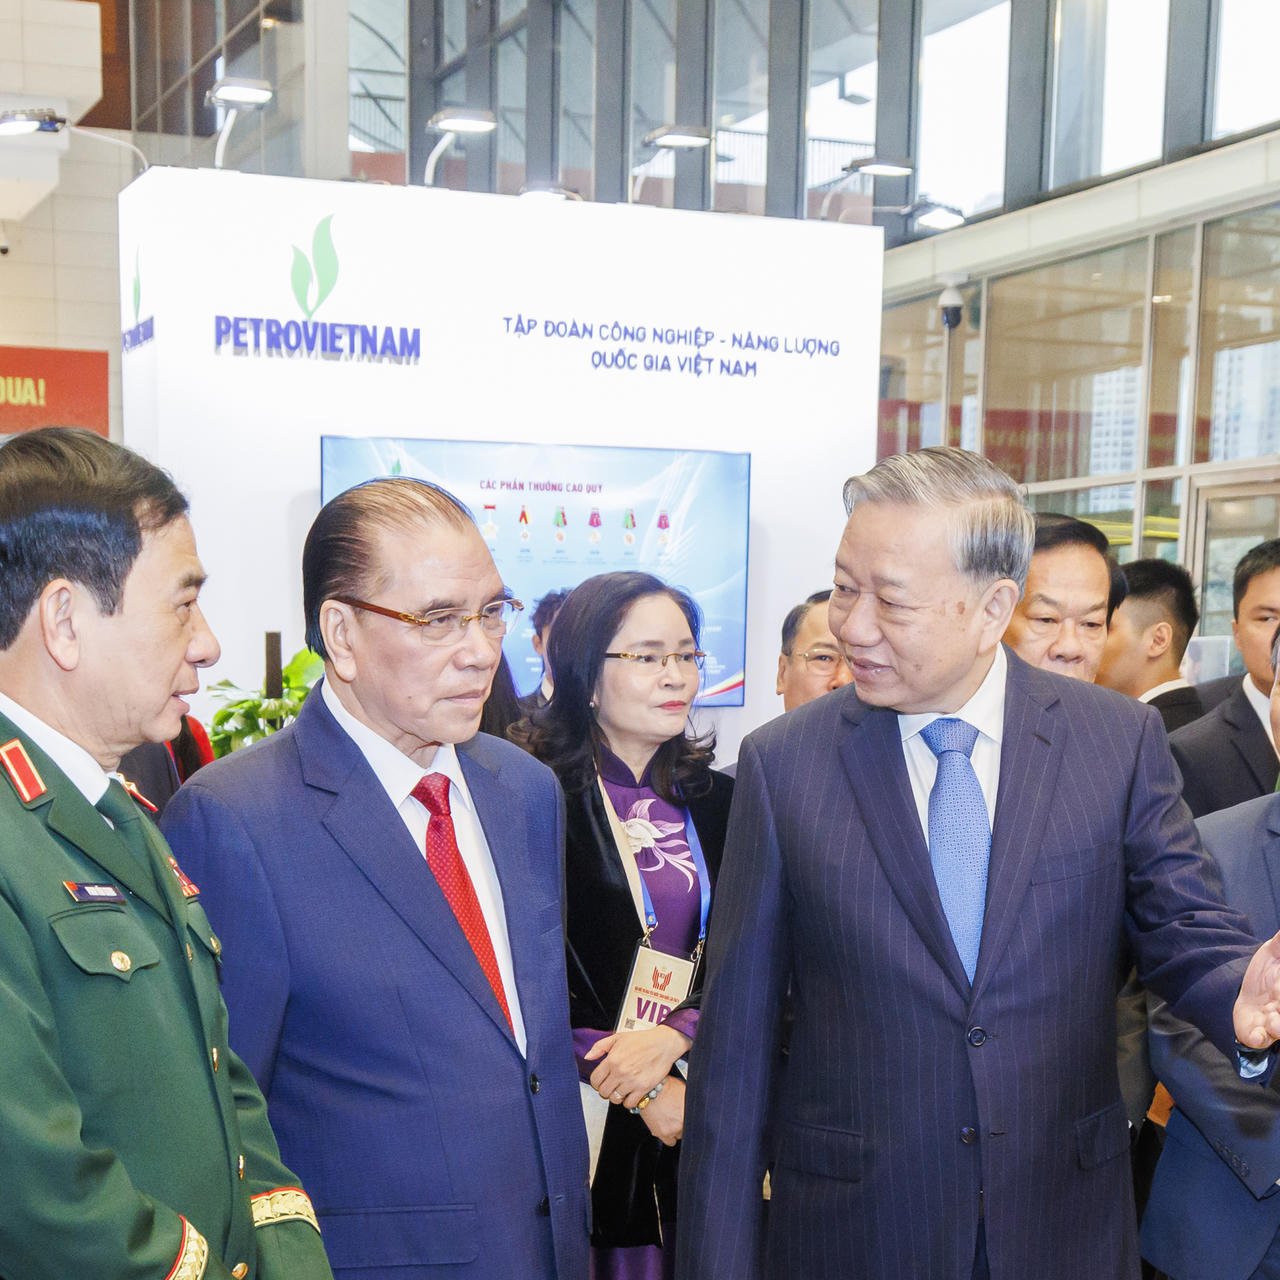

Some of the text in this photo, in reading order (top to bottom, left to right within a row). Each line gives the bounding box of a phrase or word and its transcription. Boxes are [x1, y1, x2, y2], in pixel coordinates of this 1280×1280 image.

[214, 315, 421, 359] PETROVIETNAM
[503, 314, 537, 339] TẬP
[544, 318, 594, 340] ĐOÀN
[599, 321, 646, 343] CÔNG
[652, 326, 715, 350] NGHIỆP
[731, 331, 779, 353] NĂNG
[783, 337, 840, 358] LƯỢNG
[591, 347, 757, 378] QUỐC GIA VIỆT NAM
[566, 483, 583, 493] CAO
